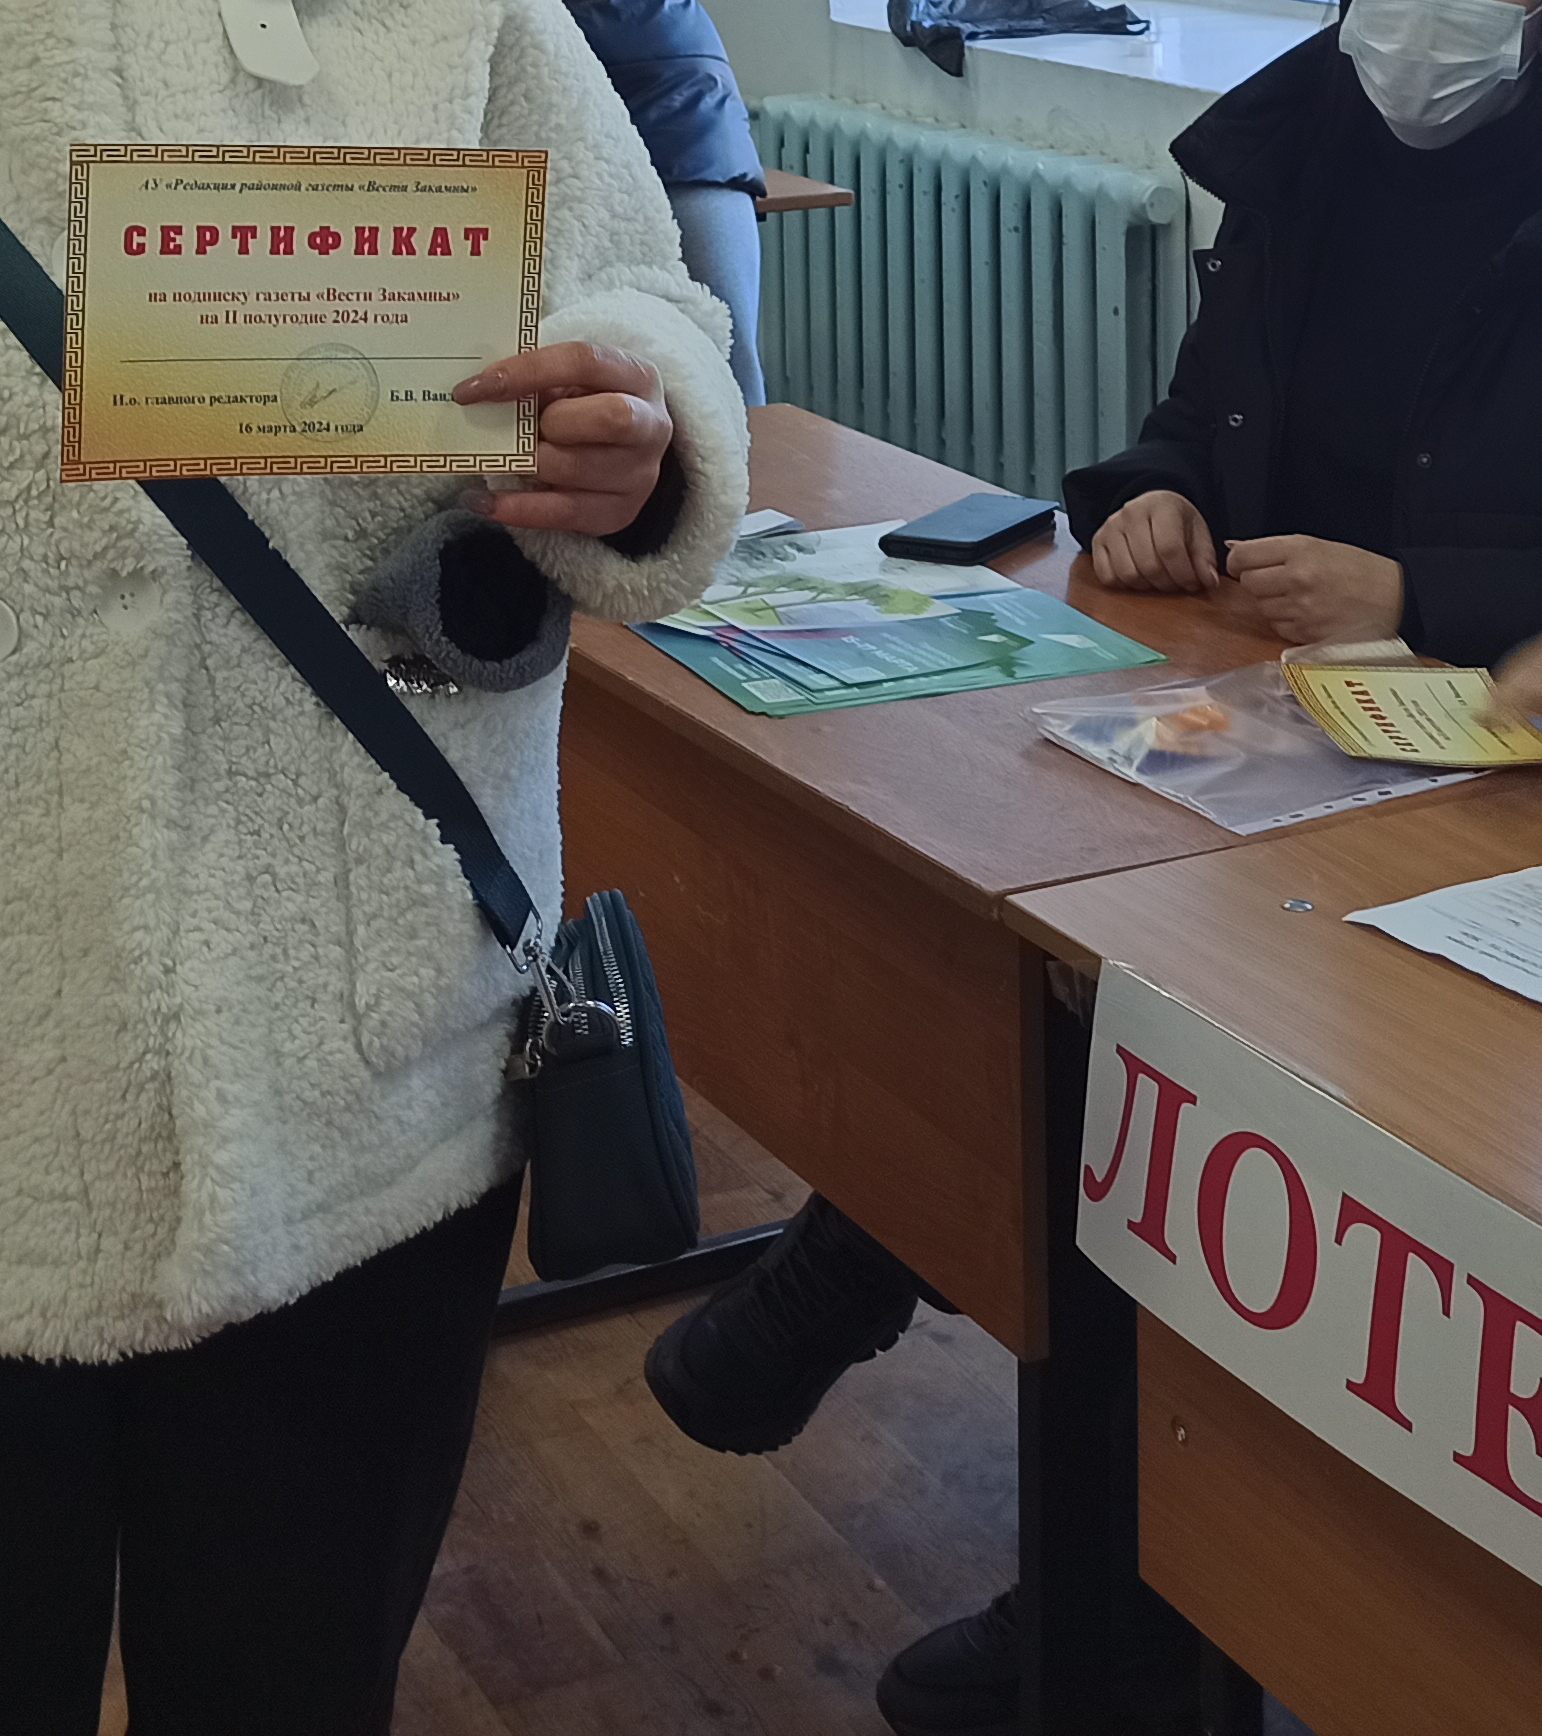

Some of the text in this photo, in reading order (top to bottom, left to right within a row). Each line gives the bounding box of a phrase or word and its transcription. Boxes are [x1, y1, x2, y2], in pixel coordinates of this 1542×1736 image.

[166, 178, 236, 193] «Редакция
[239, 180, 302, 194] районной
[305, 182, 355, 193] газеты
[358, 180, 409, 193] «Вести
[412, 180, 478, 194] Закамны»
[123, 224, 490, 257] СЕРТИФИКАТ
[148, 288, 461, 305] на подписку газеты «Вести Закамны»
[200, 313, 219, 325] на
[243, 313, 328, 328] полугодие
[332, 310, 369, 324] 2024
[373, 312, 409, 325] года
[145, 395, 206, 406] главного
[209, 394, 278, 408] редактора
[239, 421, 364, 436] 16 марта 2024 года
